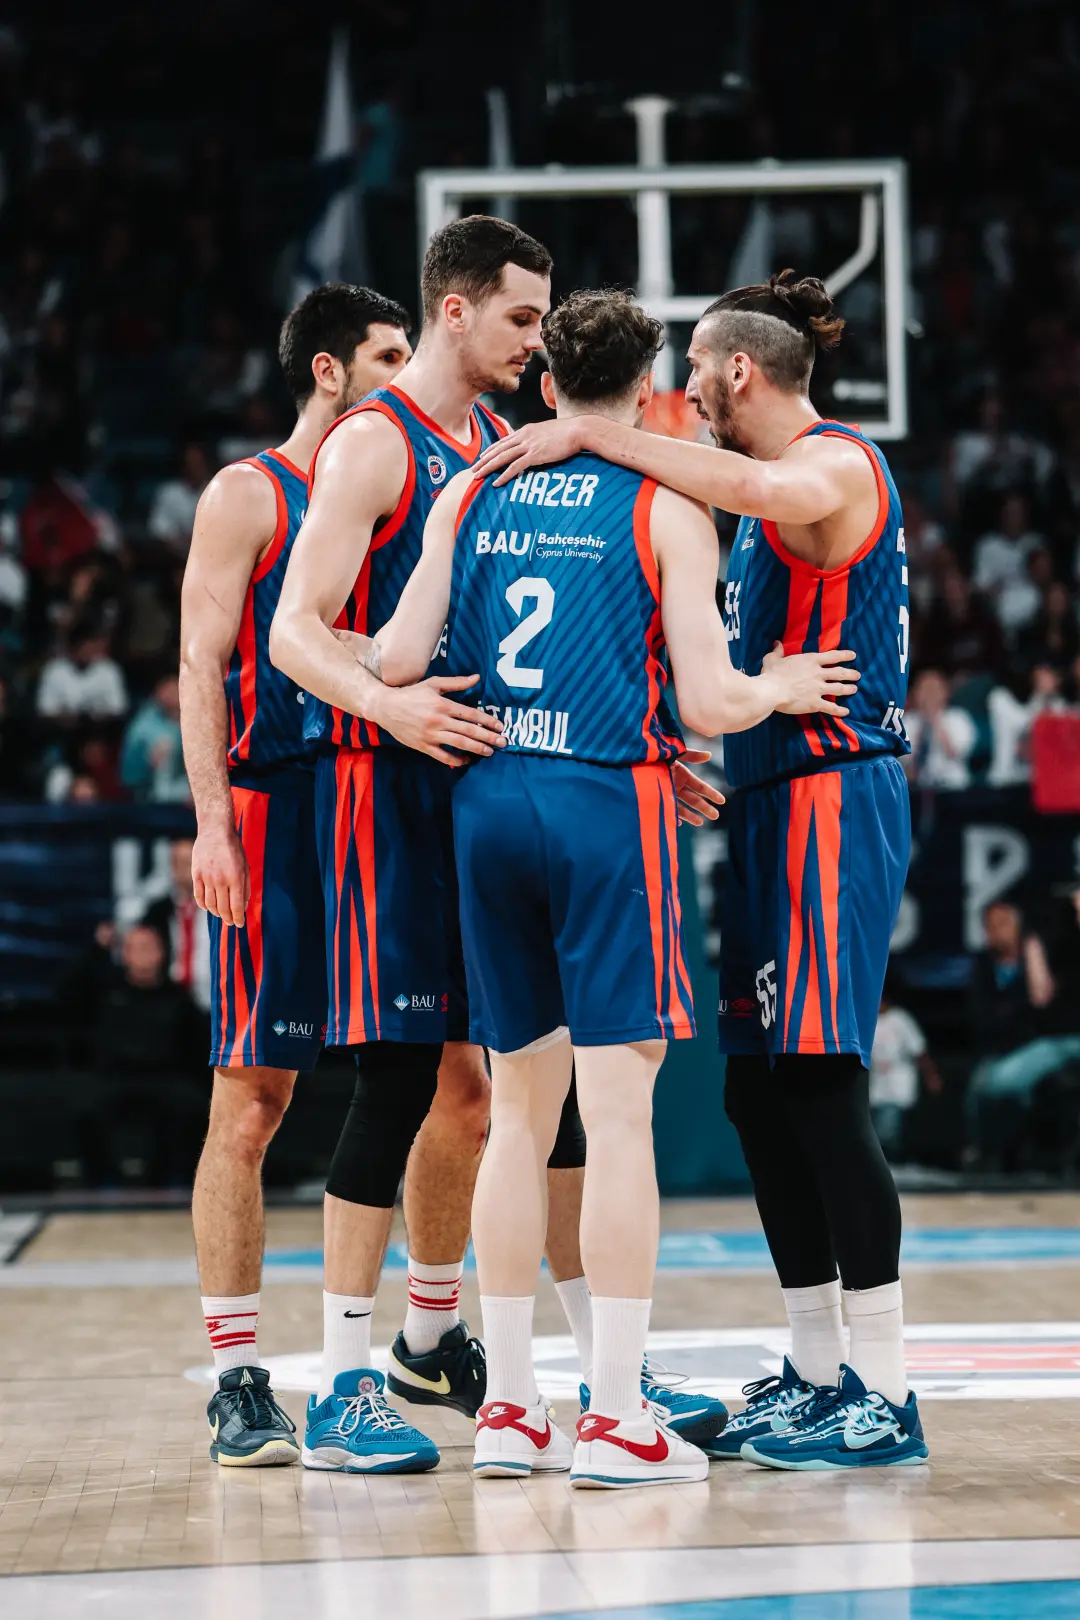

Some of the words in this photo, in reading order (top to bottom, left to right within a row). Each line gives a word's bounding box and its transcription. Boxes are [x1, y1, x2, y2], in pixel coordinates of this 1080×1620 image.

[509, 471, 600, 507] HAZER
[475, 530, 532, 556] BAU
[538, 532, 607, 549] Bahçeşehir
[536, 547, 563, 559] Cyprus
[564, 548, 604, 563] University
[496, 576, 556, 689] 2
[411, 994, 436, 1008] BAU
[288, 1021, 314, 1036] BAU
